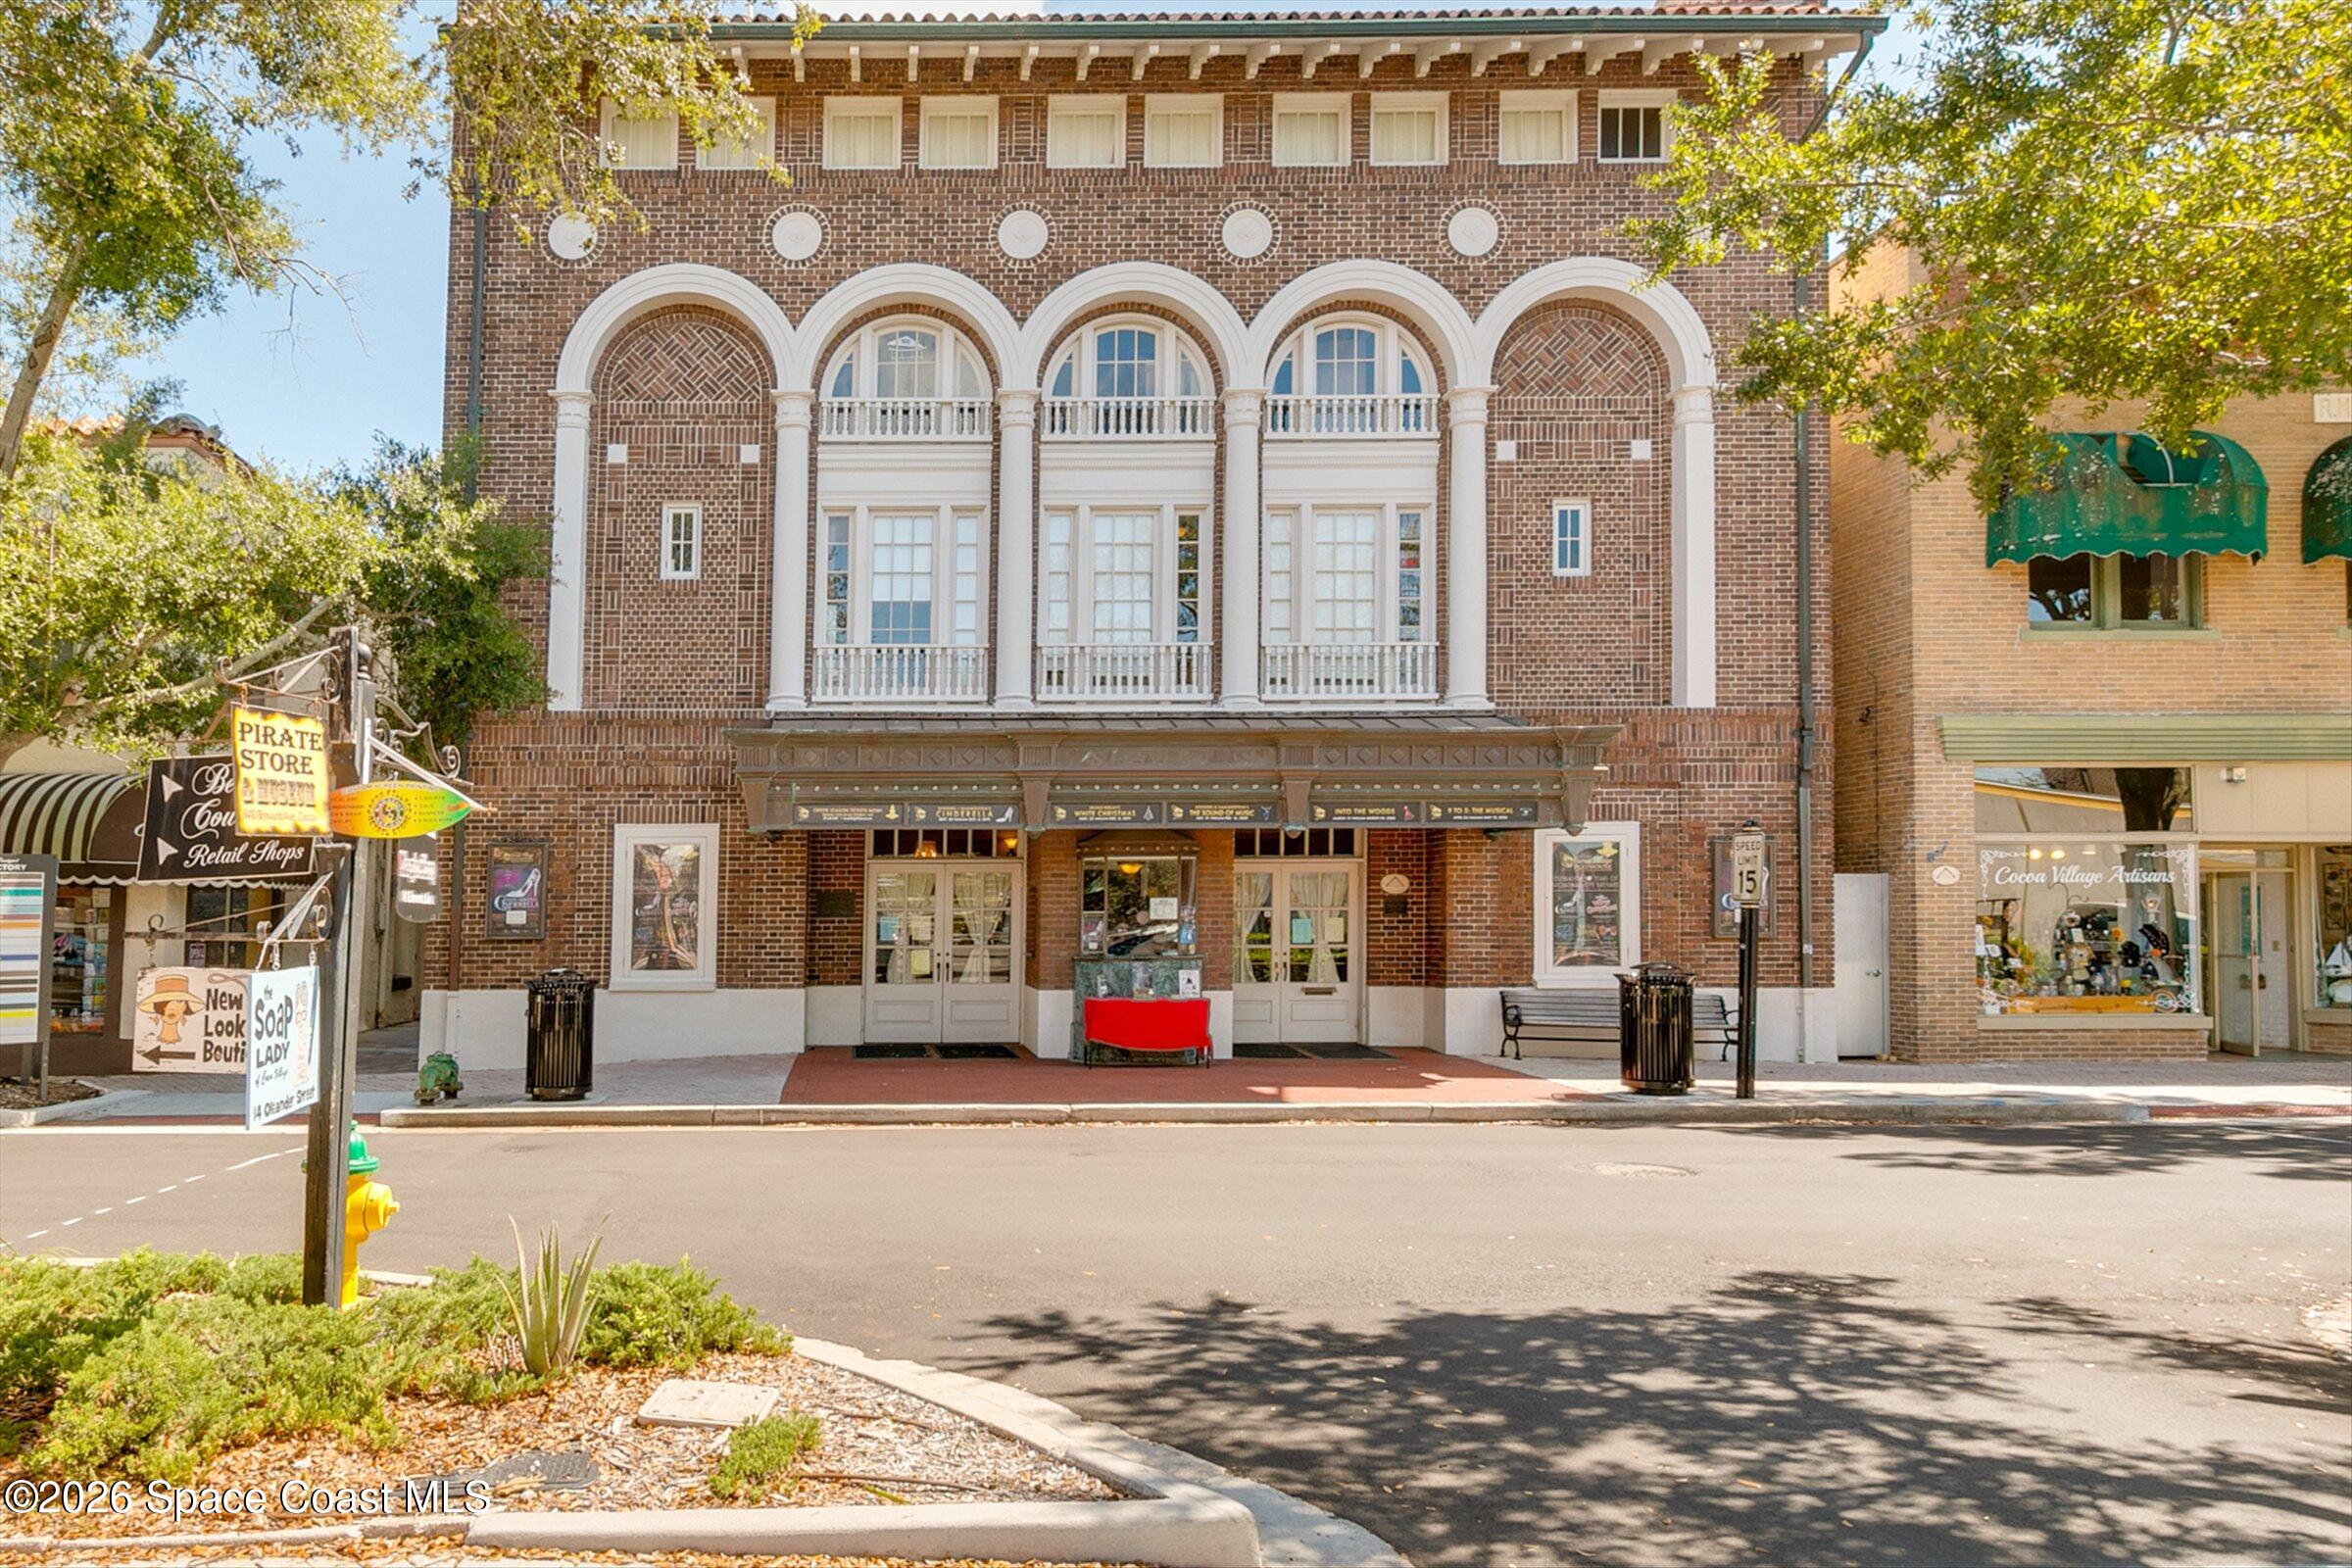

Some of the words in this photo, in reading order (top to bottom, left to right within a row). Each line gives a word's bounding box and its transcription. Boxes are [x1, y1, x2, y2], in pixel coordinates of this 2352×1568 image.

[239, 721, 322, 752] PIRATE
[240, 750, 315, 775] STORE
[257, 778, 316, 808] MUSEUM
[936, 809, 993, 818] CINDERELLA
[183, 843, 249, 868] Retail
[248, 839, 305, 869] Shops
[1736, 841, 1761, 852] SPEED
[1738, 855, 1758, 865] LIMIT
[1738, 869, 1757, 894] 15
[1994, 866, 2046, 885] Cocoa
[2050, 864, 2103, 889] Village
[2107, 865, 2176, 884] Artisans
[206, 988, 244, 1012] New
[264, 984, 273, 1001] the
[203, 1013, 247, 1039] Look
[256, 1041, 290, 1068] LADY
[253, 1103, 262, 1121] 14
[264, 1094, 295, 1118] Oleander
[296, 1085, 316, 1104] Street
